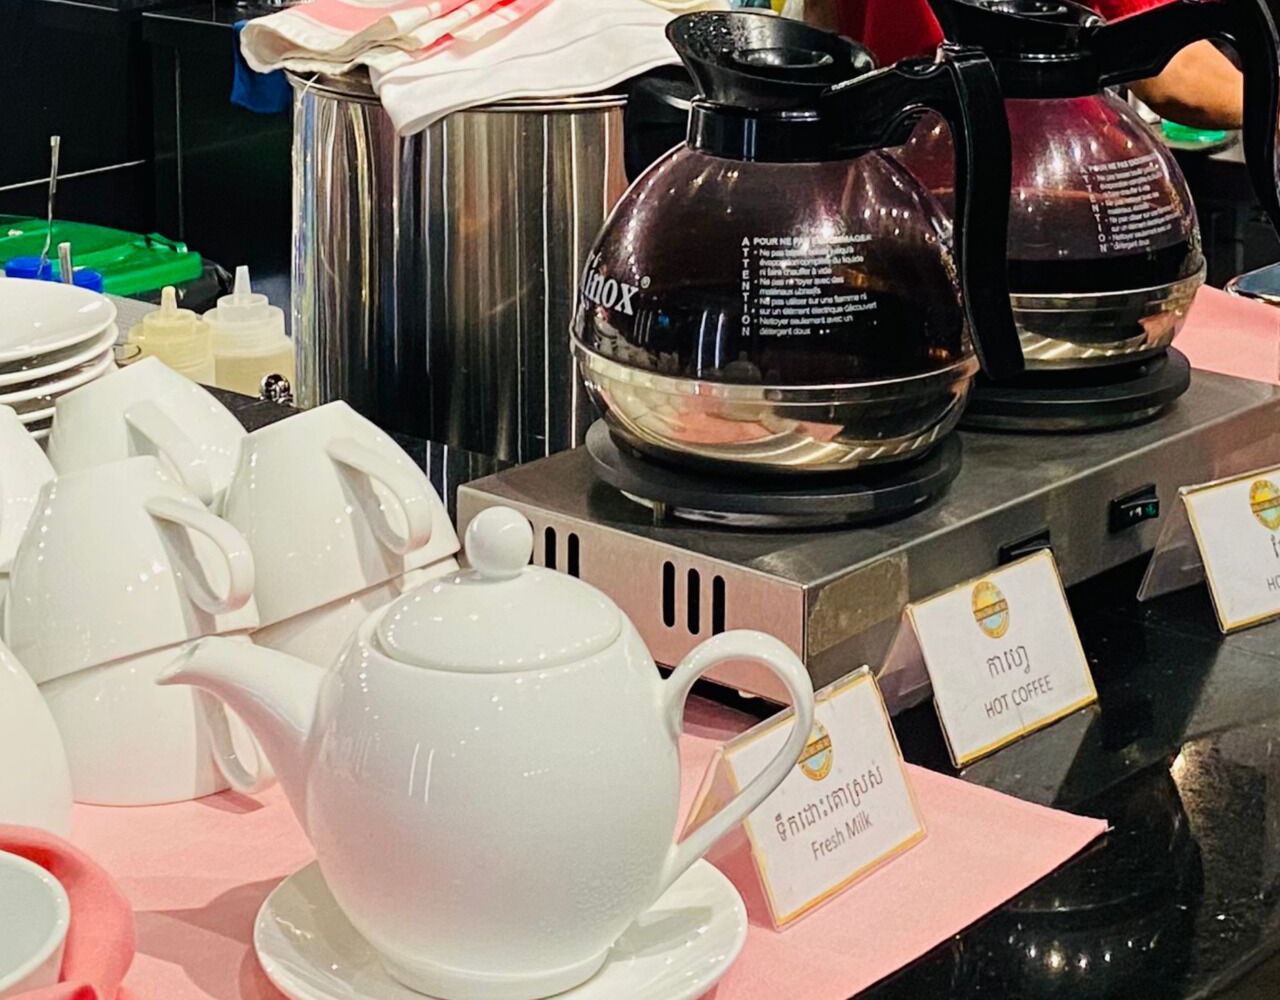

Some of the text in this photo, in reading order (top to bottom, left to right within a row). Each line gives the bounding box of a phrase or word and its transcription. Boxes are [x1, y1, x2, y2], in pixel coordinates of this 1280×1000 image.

[753, 237, 778, 246] POUR
[780, 237, 792, 245] NE
[741, 236, 750, 337] ATTENTION
[984, 674, 1054, 719] HOT COFFEE
[811, 810, 873, 861] Fresh Milk
